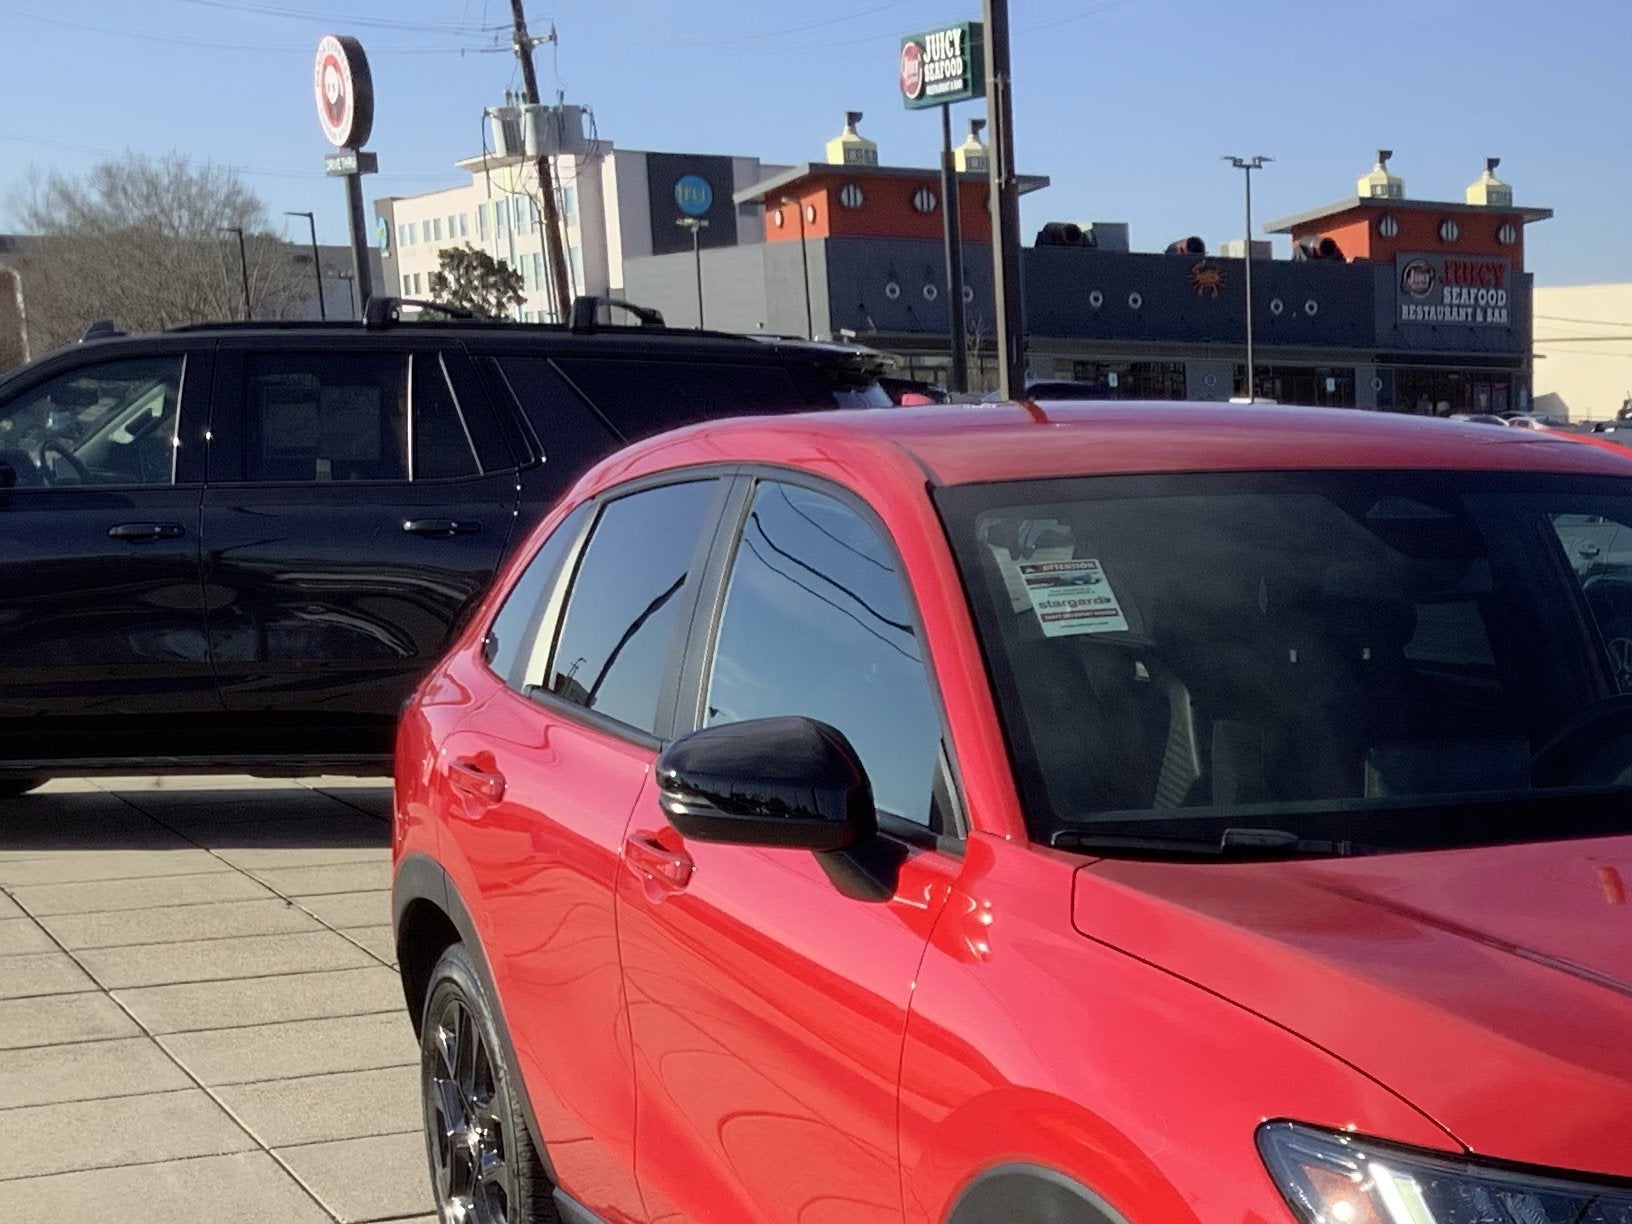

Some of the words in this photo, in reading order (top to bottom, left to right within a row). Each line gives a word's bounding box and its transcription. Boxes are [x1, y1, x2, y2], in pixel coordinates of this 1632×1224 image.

[923, 28, 962, 63] JUICY
[924, 56, 963, 82] SEAFOOD
[1440, 261, 1504, 288] JUICY
[1443, 287, 1507, 307] SEAFOOD
[1402, 304, 1474, 321] RESTAURANT
[1476, 308, 1484, 322] &
[1486, 308, 1508, 323] BAR
